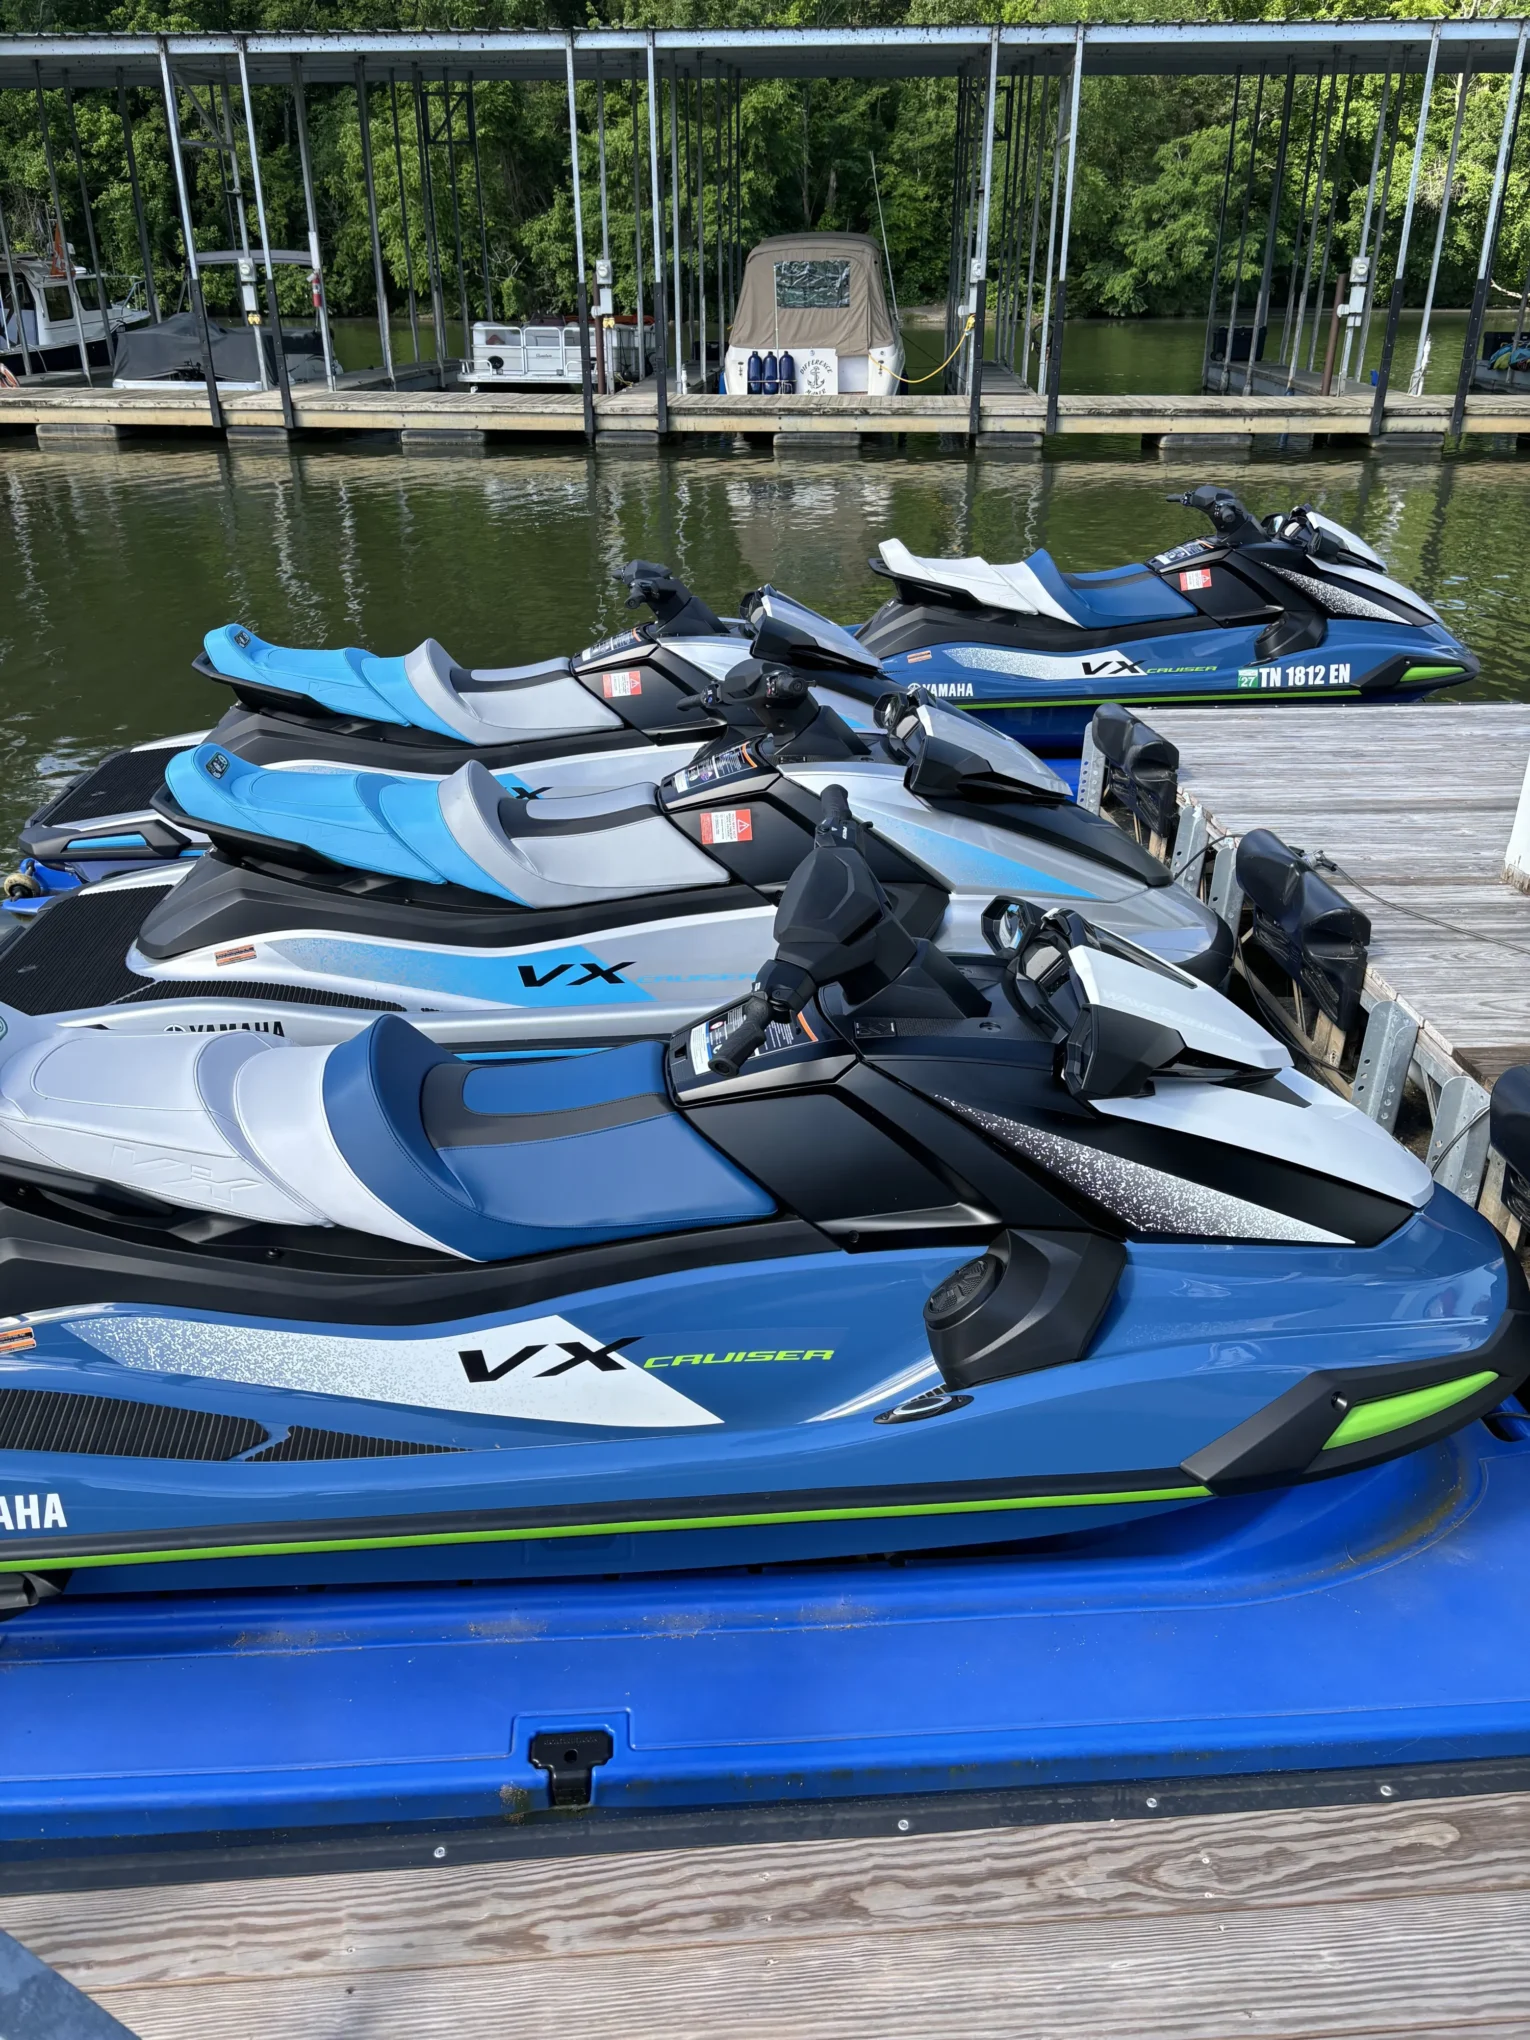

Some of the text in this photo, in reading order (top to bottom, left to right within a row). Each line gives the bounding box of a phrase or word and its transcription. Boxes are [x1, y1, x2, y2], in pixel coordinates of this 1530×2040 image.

[799, 359, 833, 375] DIFFERENCE
[1082, 660, 1218, 675] VX CRUISER
[1259, 663, 1350, 688] TN 1812 EN
[922, 683, 974, 697] YAMAHA
[504, 786, 554, 800] X
[517, 961, 637, 988] VX
[458, 1335, 835, 1383] VX CRUISER
